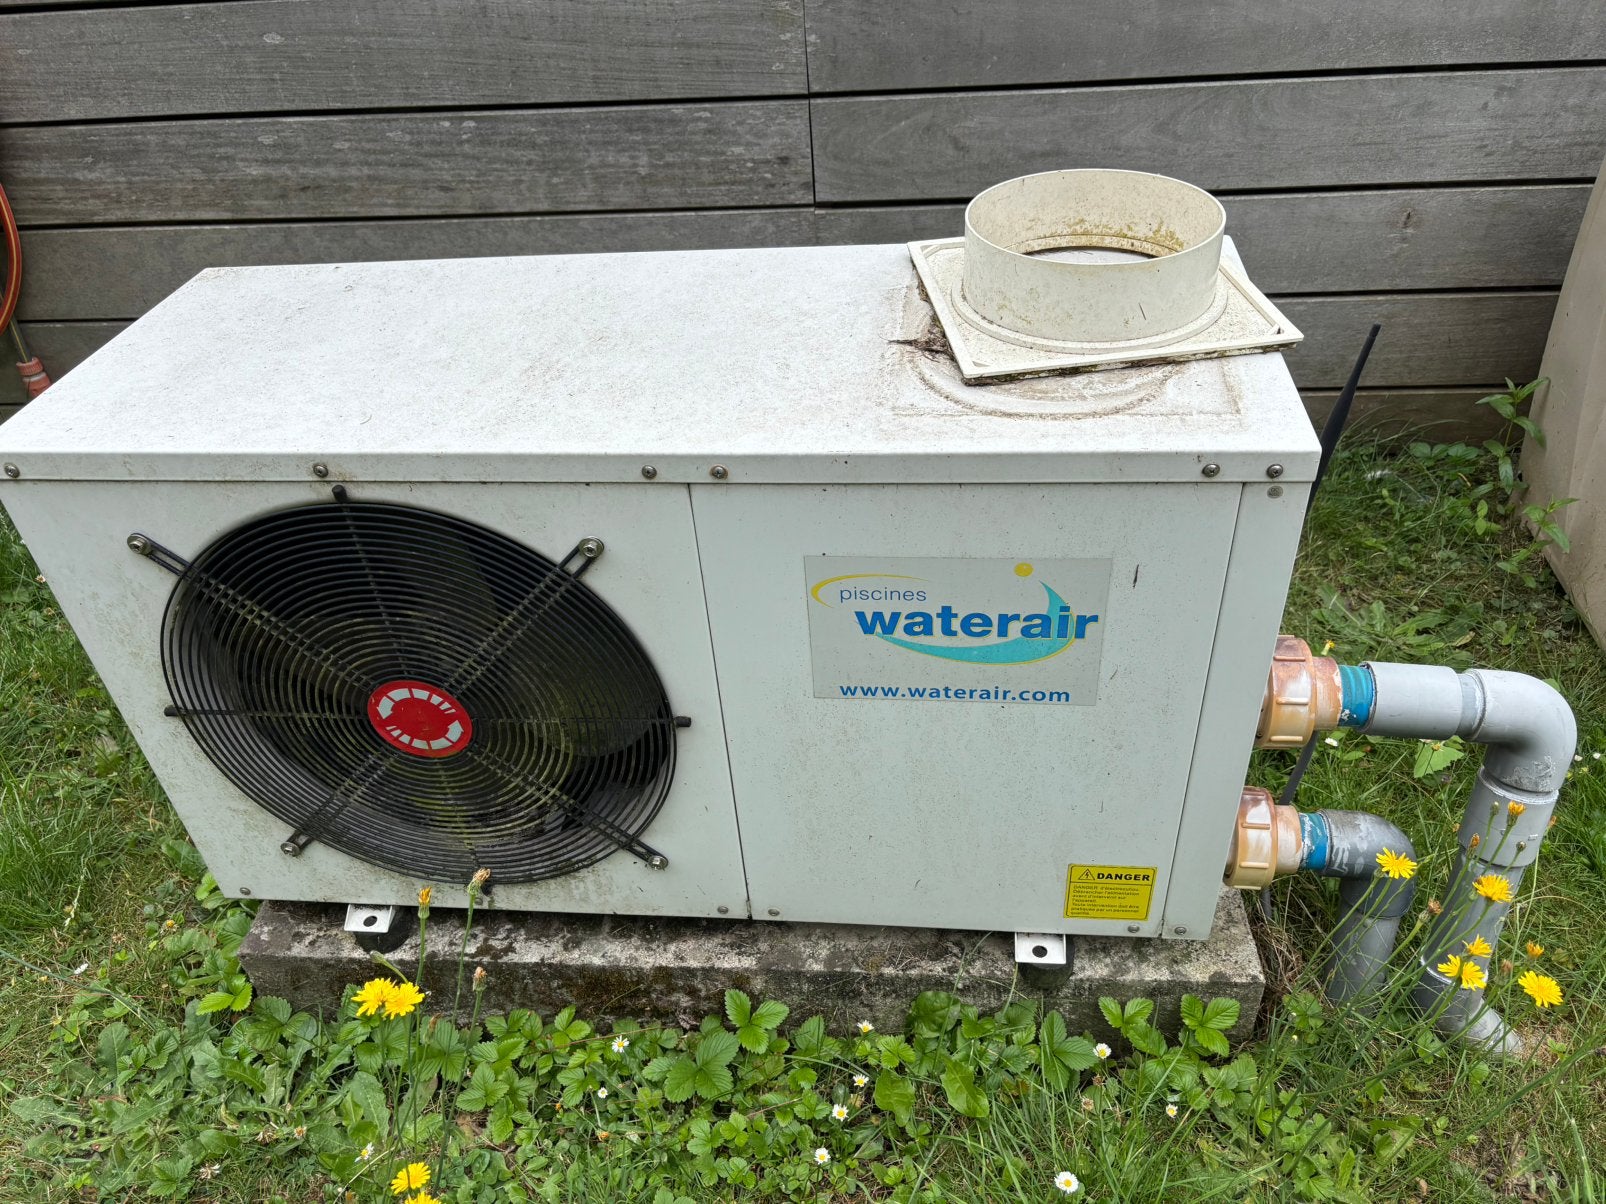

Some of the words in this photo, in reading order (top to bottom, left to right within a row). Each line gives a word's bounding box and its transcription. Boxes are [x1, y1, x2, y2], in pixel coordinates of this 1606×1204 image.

[840, 586, 927, 603] piscines
[854, 605, 1099, 639] waterair
[840, 685, 1071, 703] www.waterair.com
[1097, 872, 1151, 881] DANGER
